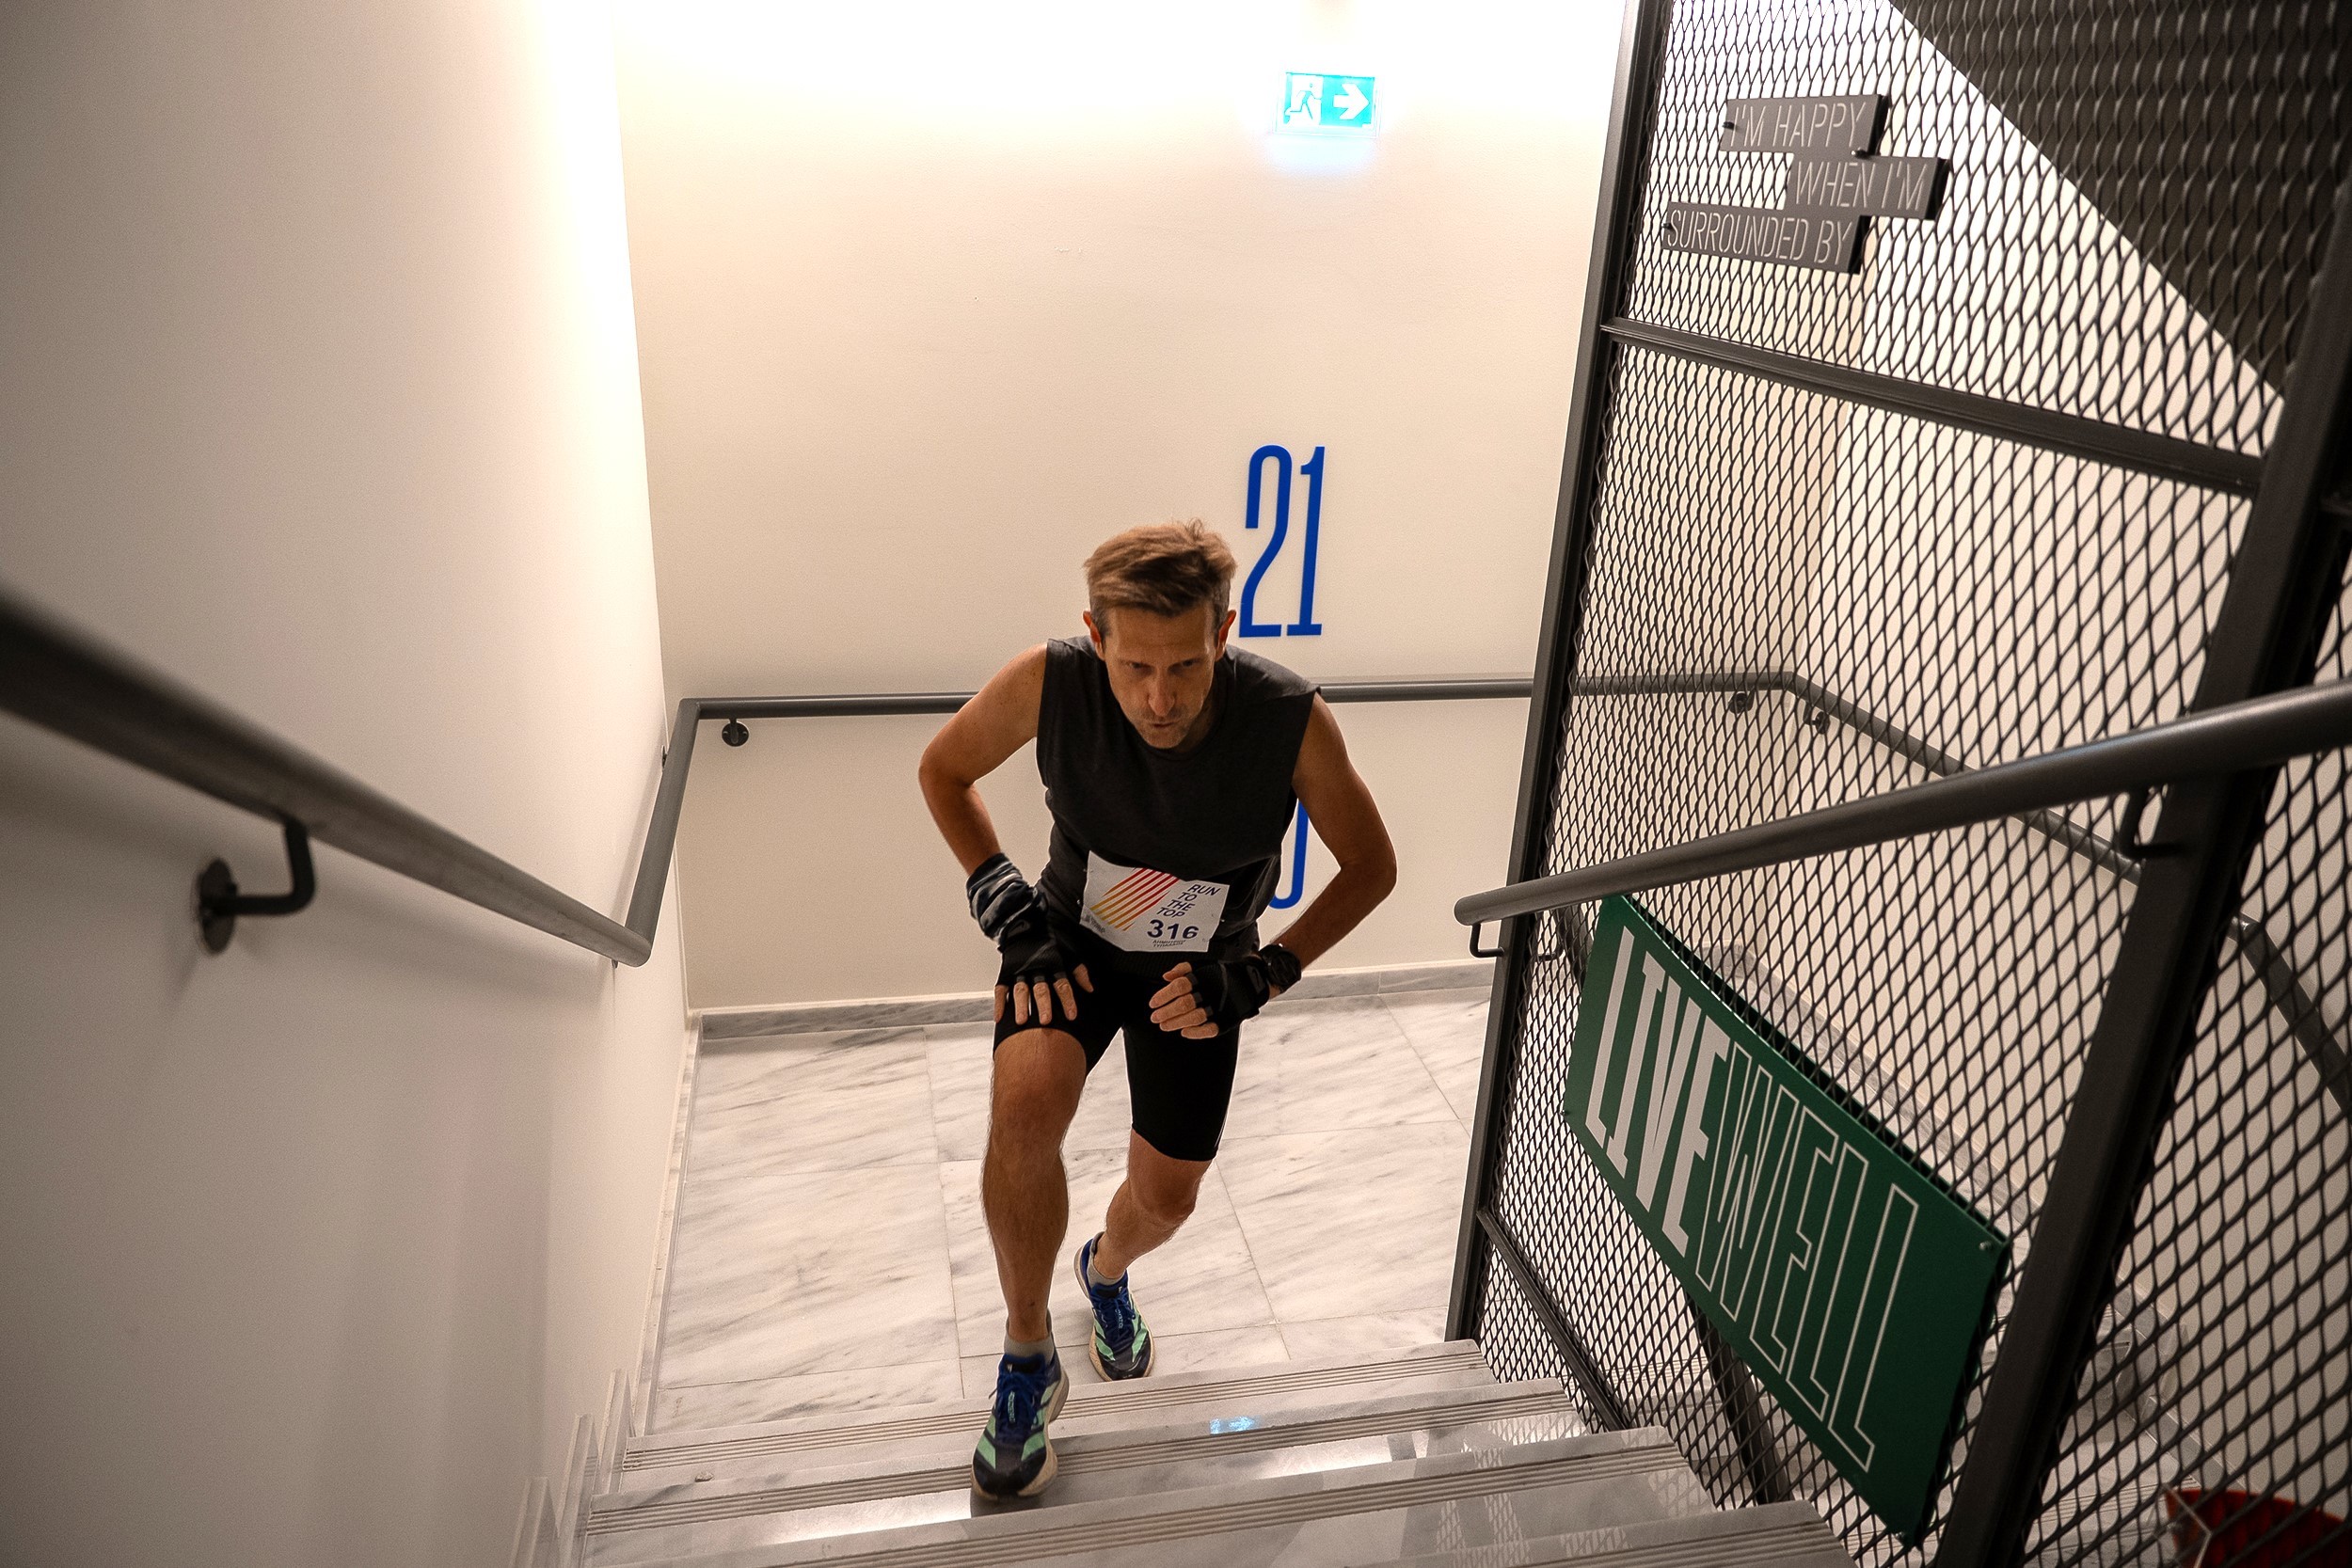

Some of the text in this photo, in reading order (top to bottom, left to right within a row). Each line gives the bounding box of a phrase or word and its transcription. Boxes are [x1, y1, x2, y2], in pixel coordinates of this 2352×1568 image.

[1729, 101, 1867, 149] I'M HAPPY
[1795, 161, 1929, 212] WHEN I'M
[1666, 208, 1854, 266] SURROUNDED BY
[1238, 444, 1326, 638] 21
[1177, 892, 1198, 901] TO
[1187, 884, 1221, 895] RUN
[1156, 907, 1185, 918] TOP
[1167, 899, 1196, 911] THE
[1147, 919, 1200, 940] 316
